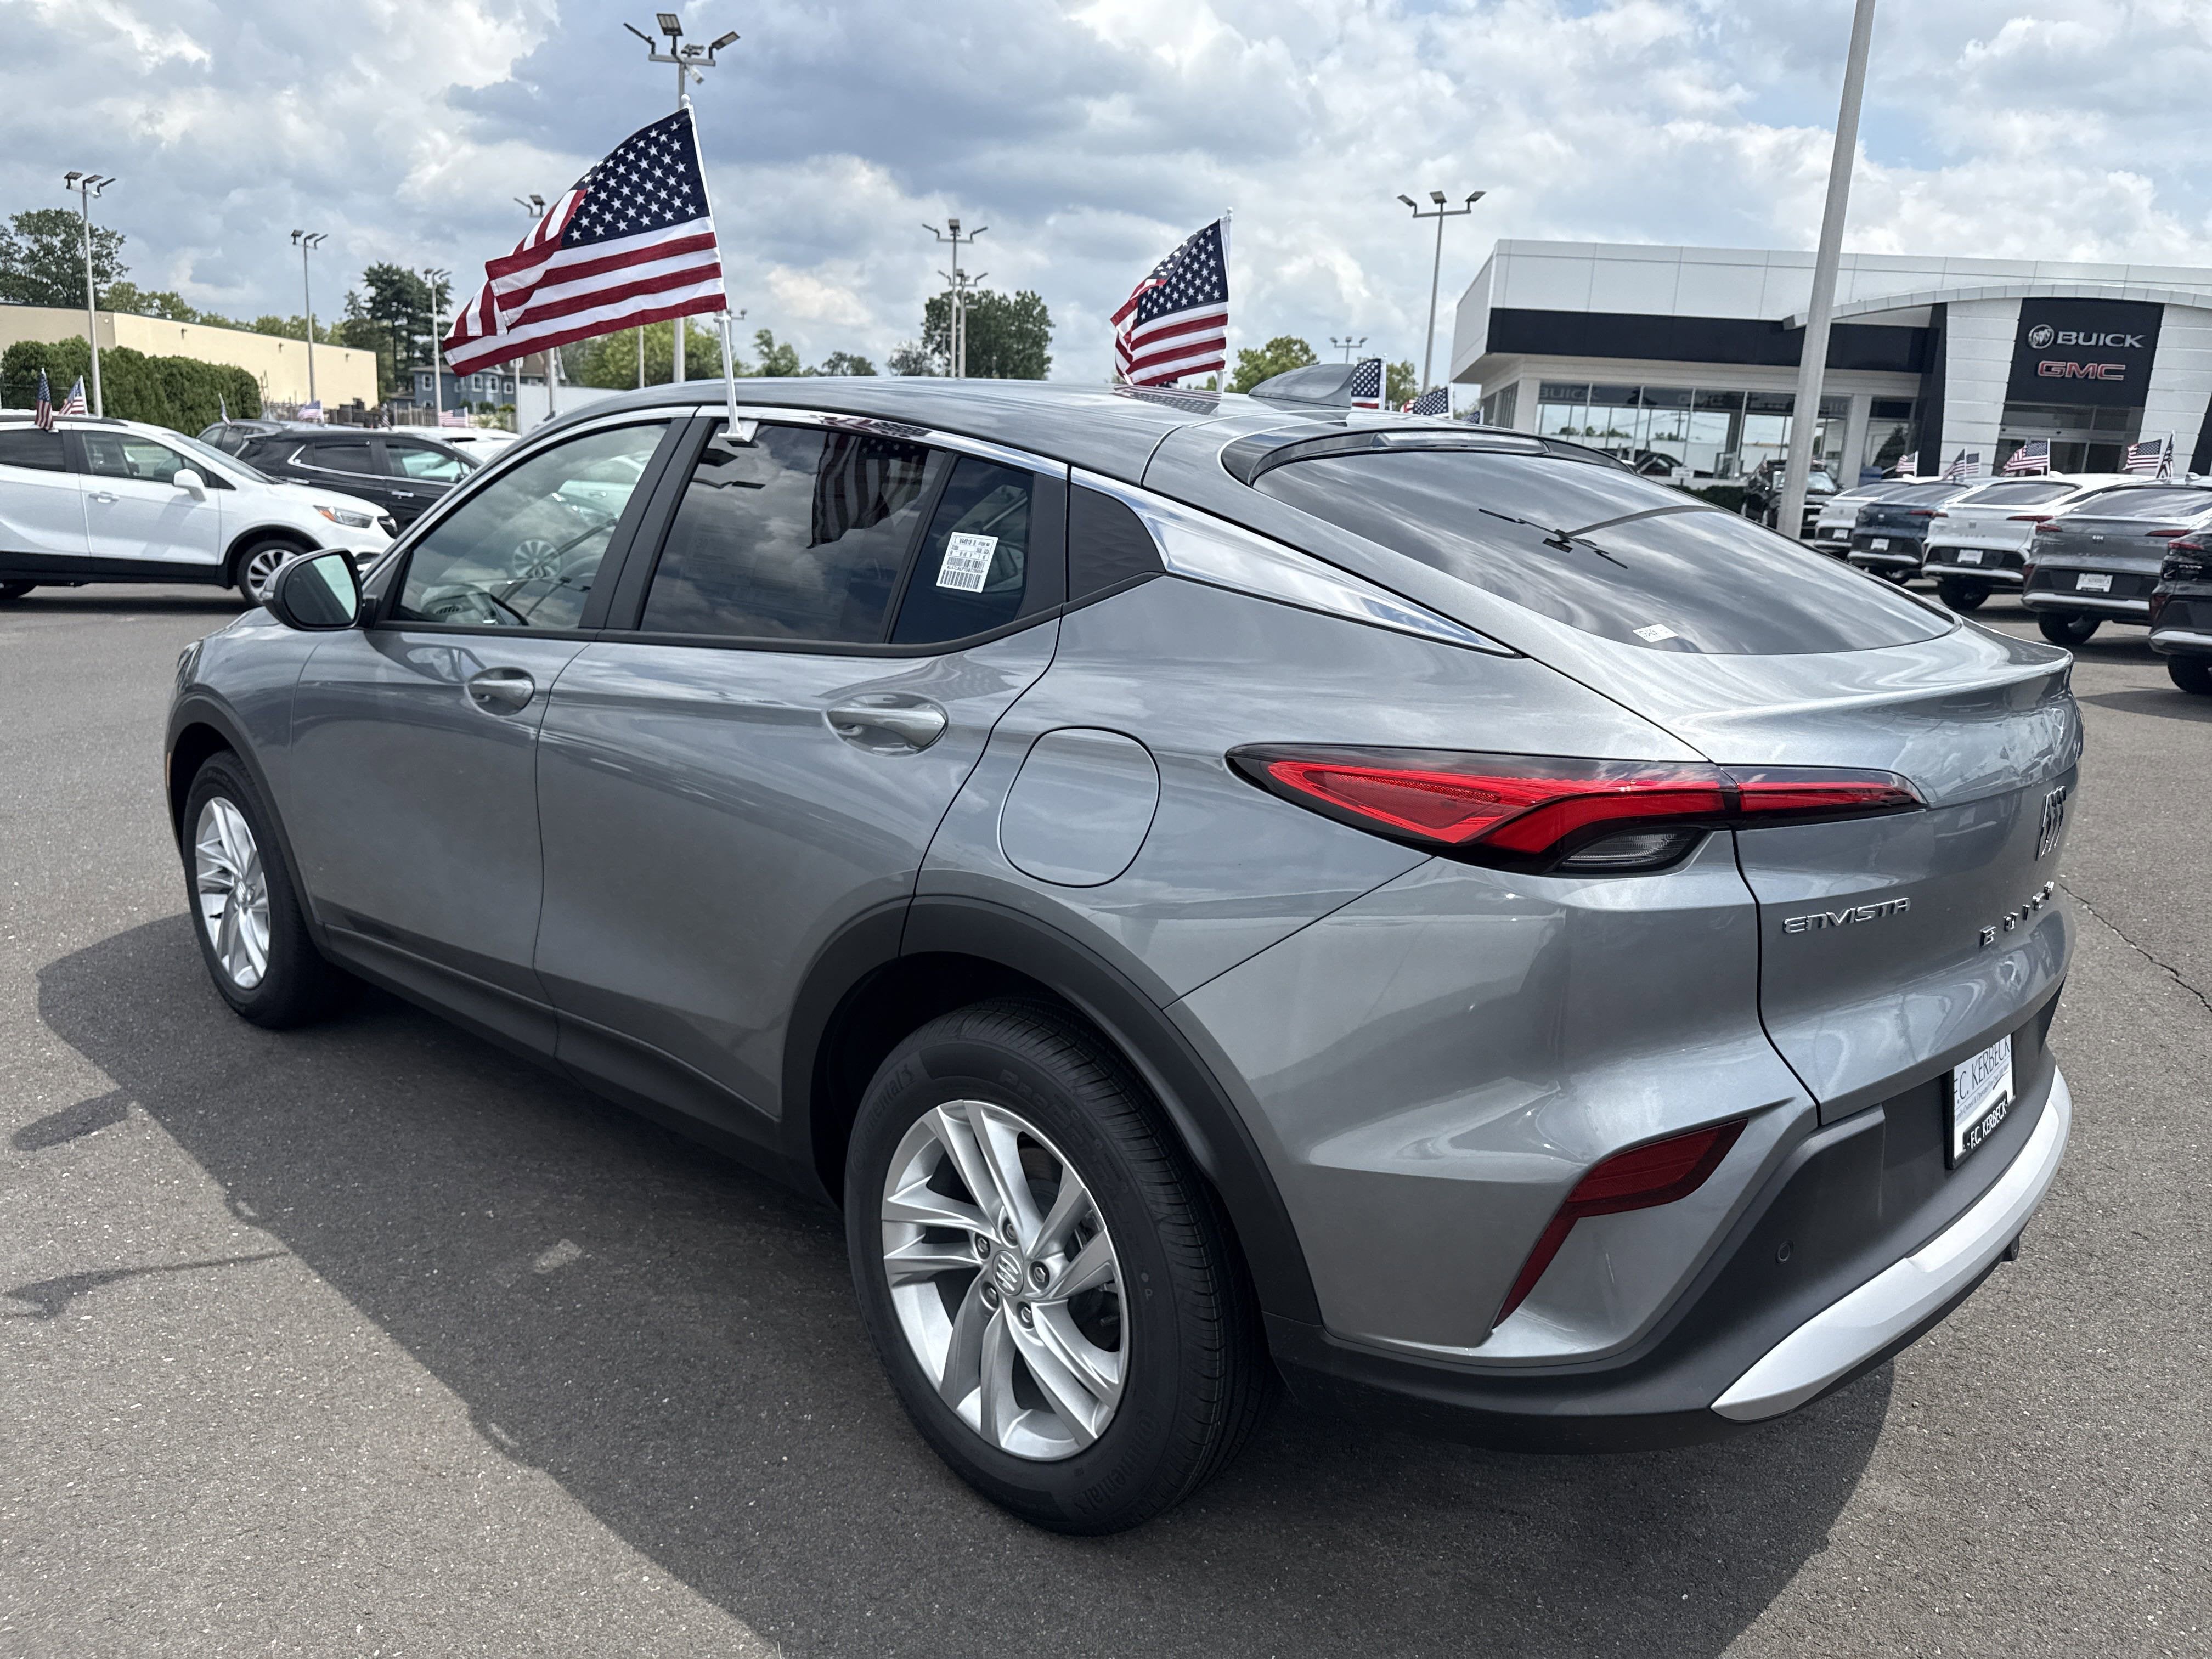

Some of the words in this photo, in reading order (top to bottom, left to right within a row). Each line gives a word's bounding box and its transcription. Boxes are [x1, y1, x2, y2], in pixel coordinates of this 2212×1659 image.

[2056, 331, 2145, 348] BUICK
[2037, 360, 2126, 381] GMC
[1784, 897, 1911, 934] ENVISTA
[1972, 1036, 2010, 1090] KERBECK
[1982, 1098, 2007, 1138] KERBECK
